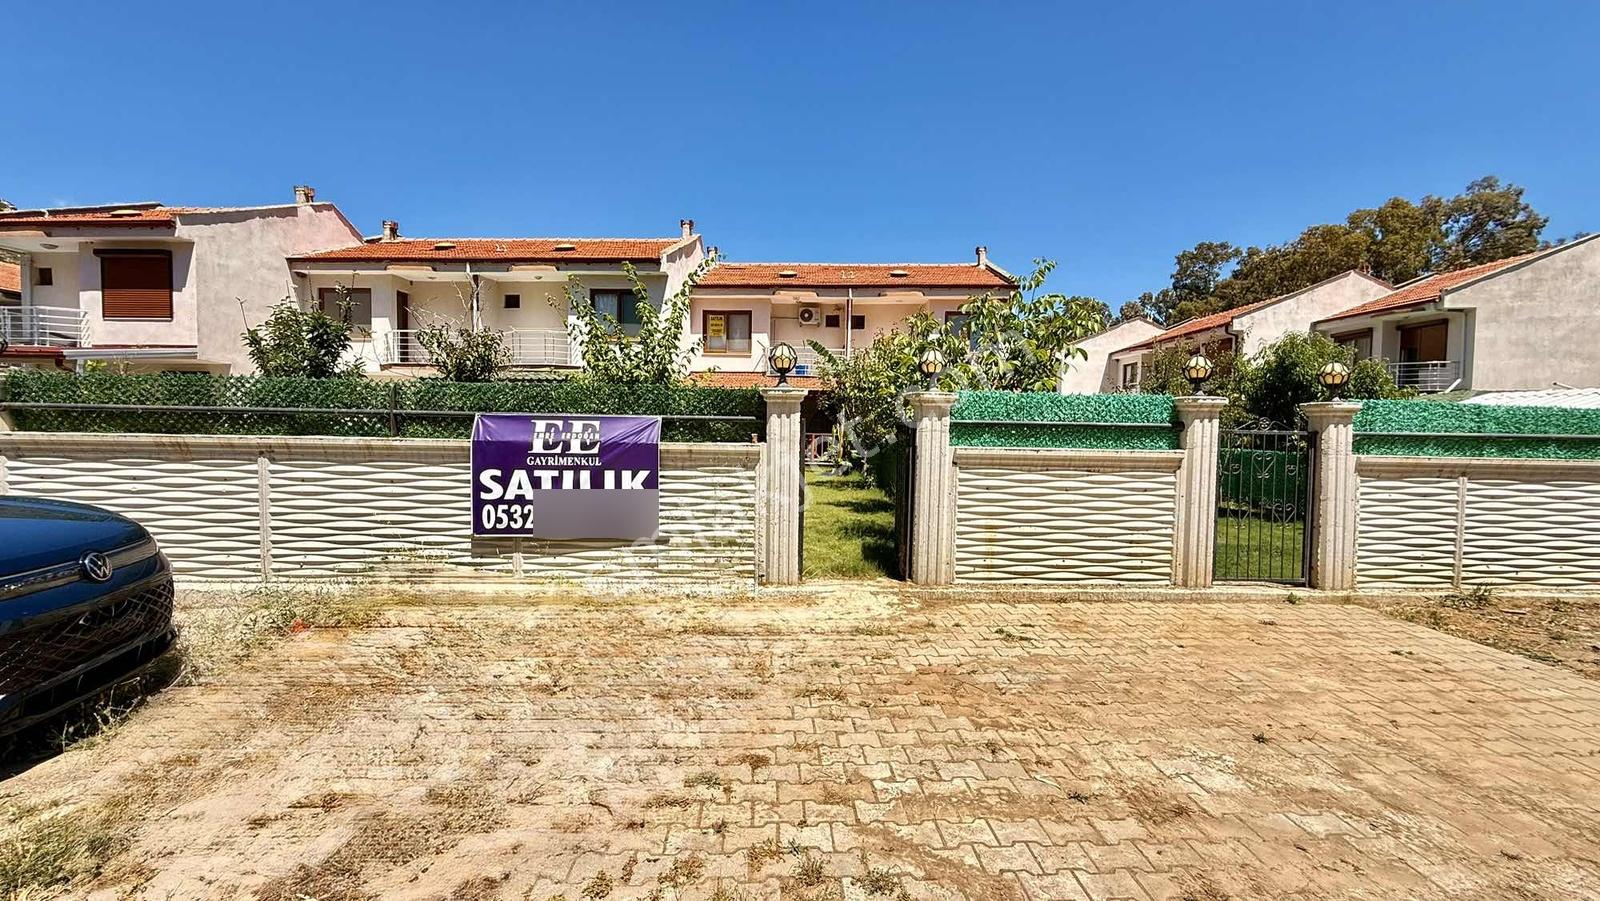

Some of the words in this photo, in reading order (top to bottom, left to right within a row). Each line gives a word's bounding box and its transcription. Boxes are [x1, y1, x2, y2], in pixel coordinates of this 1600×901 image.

[528, 420, 600, 454] EE
[527, 455, 601, 466] GAYRİMENKUL
[482, 504, 533, 529] 0532
